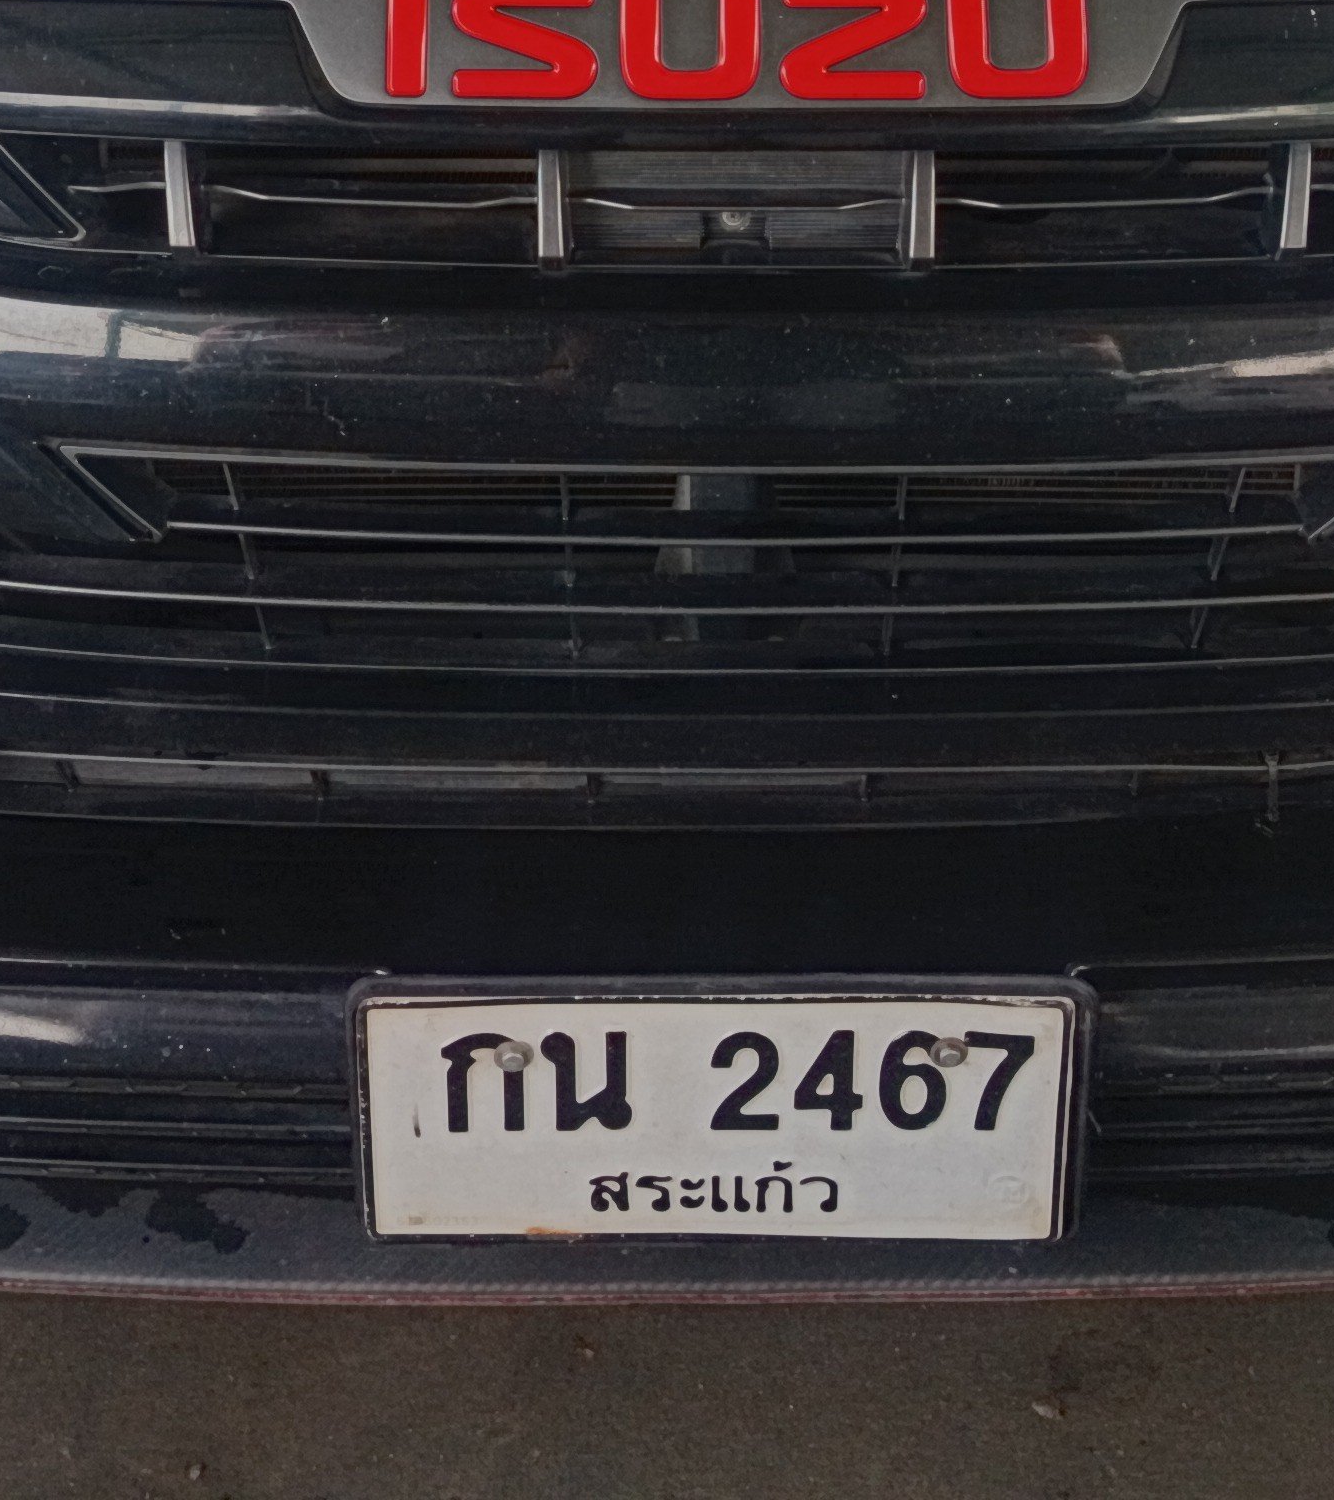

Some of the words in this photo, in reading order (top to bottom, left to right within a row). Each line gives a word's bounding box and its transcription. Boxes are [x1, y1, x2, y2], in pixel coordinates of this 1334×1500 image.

[440, 1030, 633, 1133] กน
[709, 1029, 1036, 1132] 2467
[588, 1160, 839, 1213] สระแก้ว
